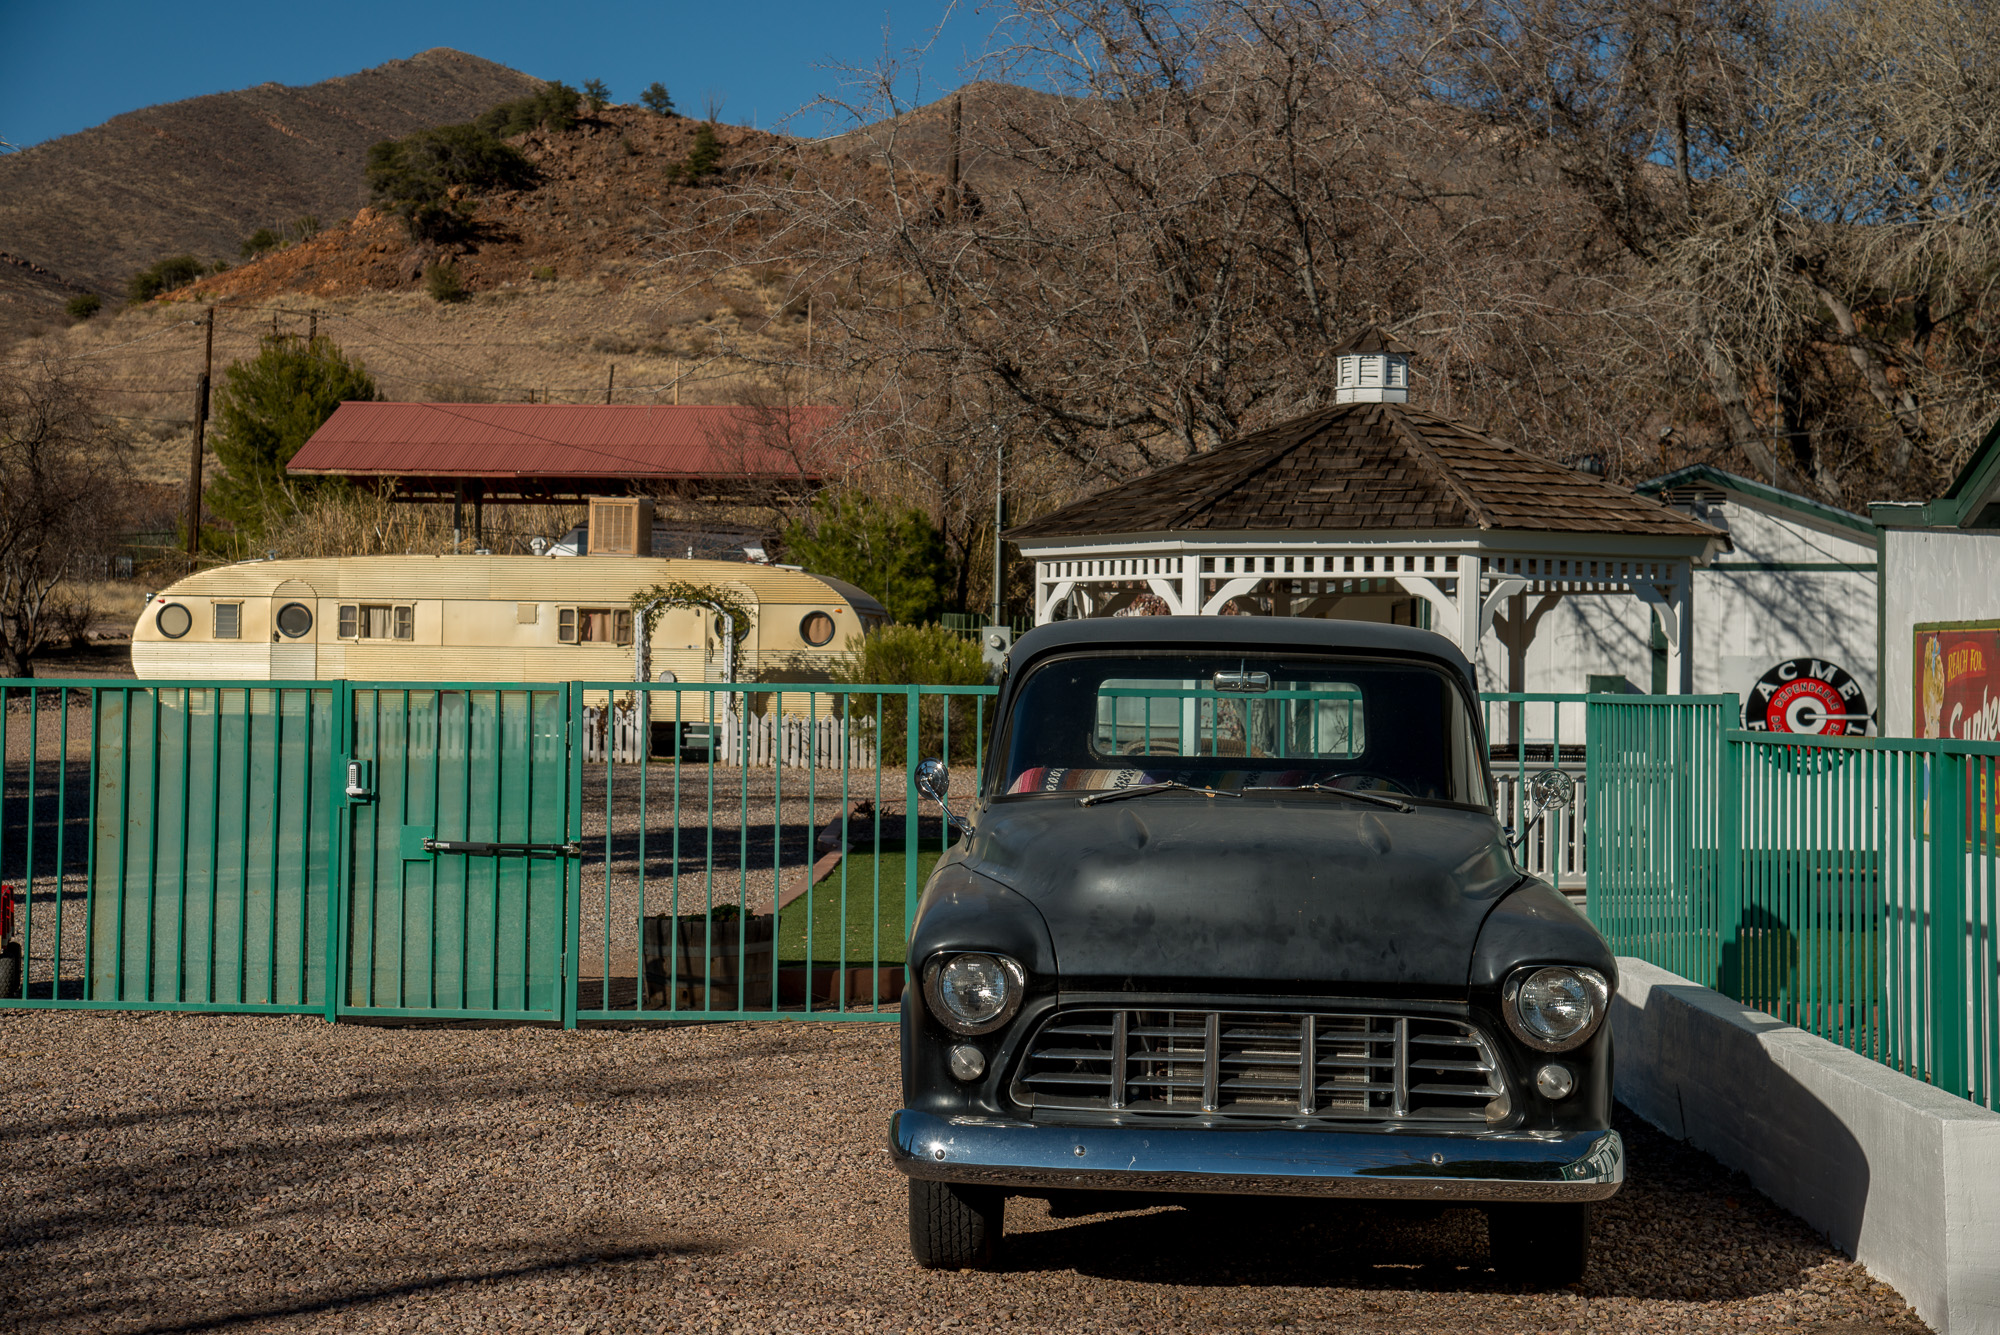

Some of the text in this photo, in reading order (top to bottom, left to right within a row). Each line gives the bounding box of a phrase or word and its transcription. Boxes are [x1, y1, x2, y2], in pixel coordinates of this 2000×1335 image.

[1756, 659, 1860, 702] ACME
[1948, 649, 1968, 682] REACH
[1774, 682, 1840, 710] DEPENDABLE
[1949, 684, 2000, 741] Sunbe
